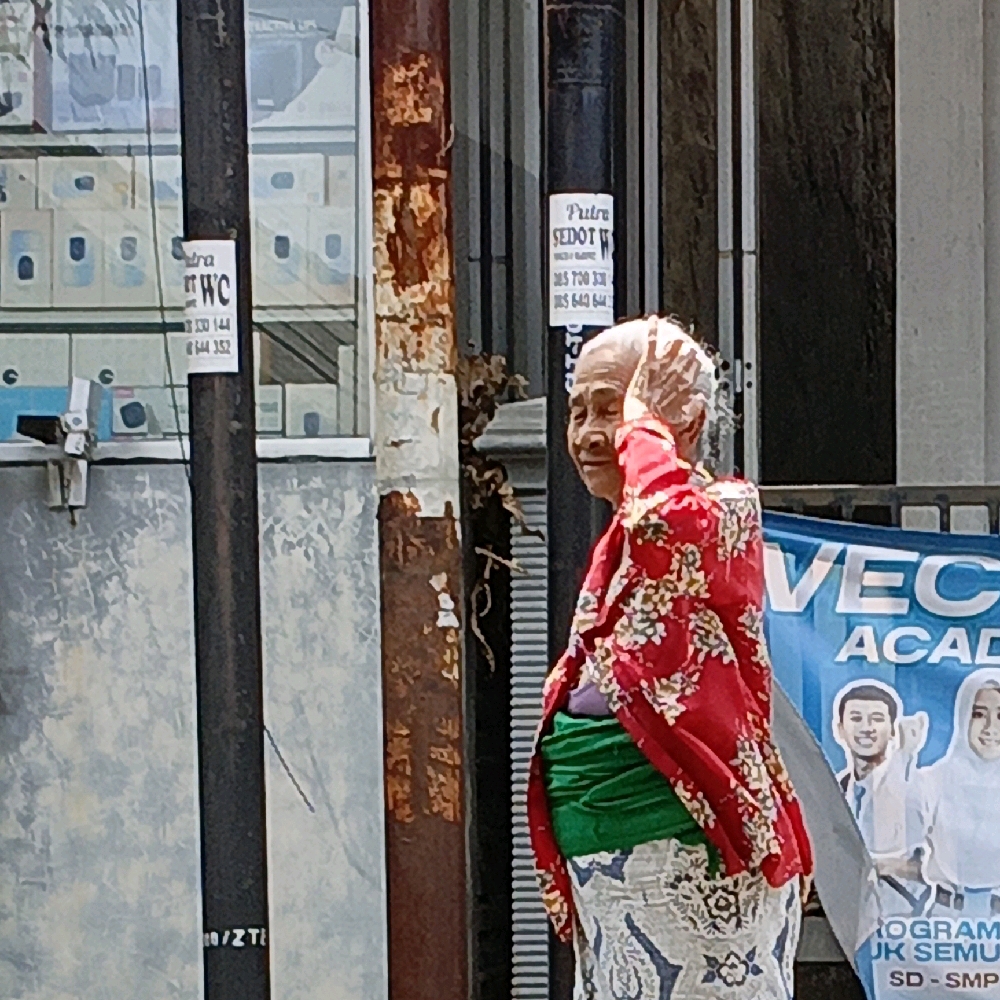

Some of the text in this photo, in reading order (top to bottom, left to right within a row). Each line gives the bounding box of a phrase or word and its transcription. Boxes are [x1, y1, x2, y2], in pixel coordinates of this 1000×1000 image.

[200, 272, 231, 307] WC
[889, 970, 924, 987] SD
[945, 972, 1000, 988] SMP
